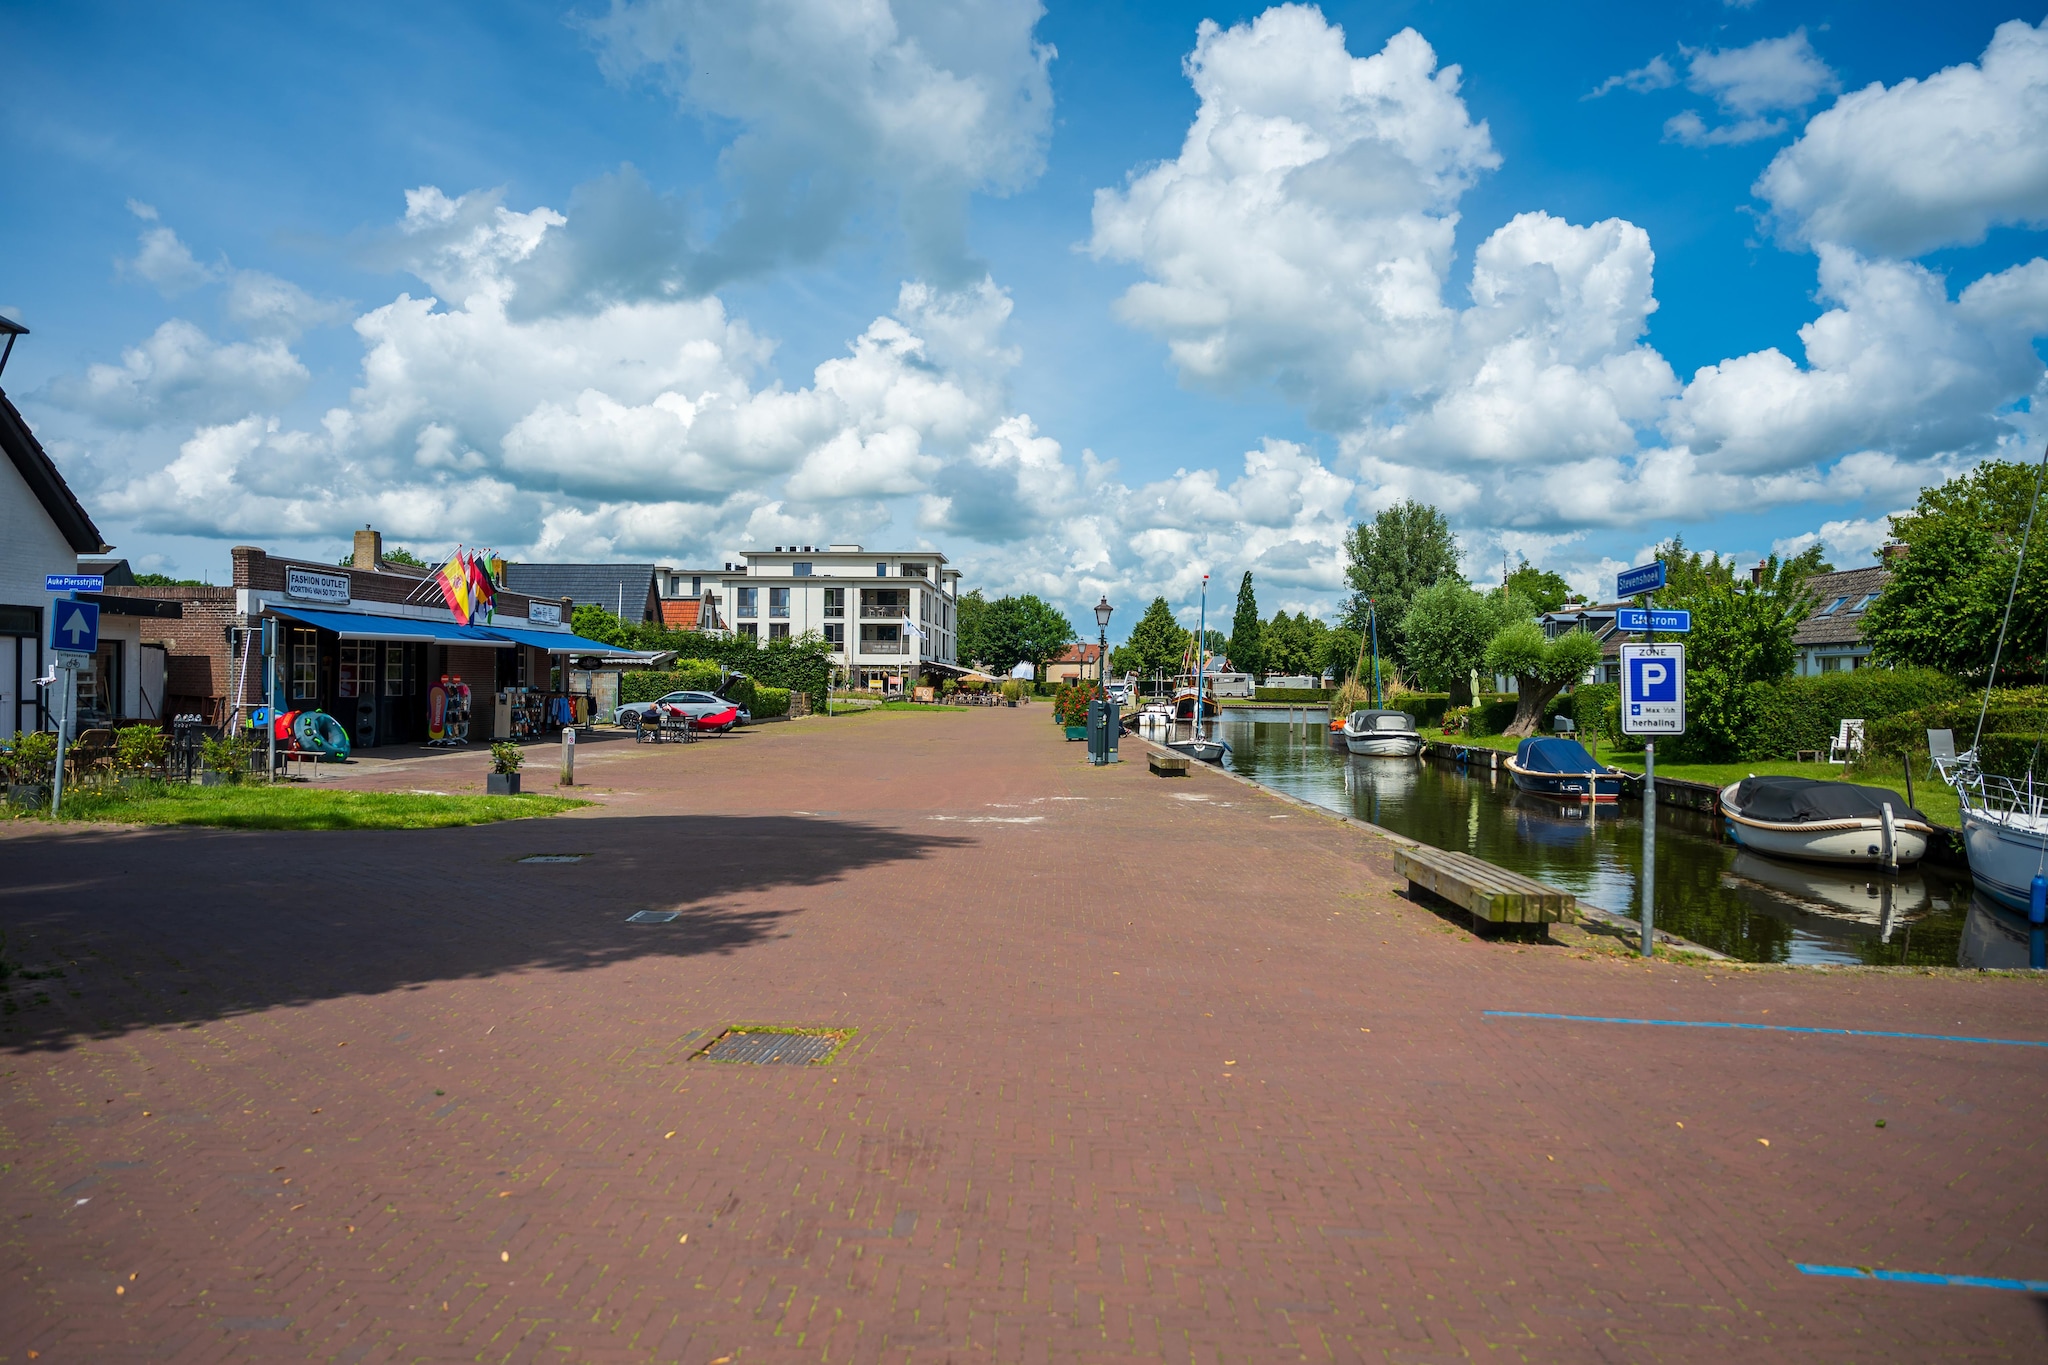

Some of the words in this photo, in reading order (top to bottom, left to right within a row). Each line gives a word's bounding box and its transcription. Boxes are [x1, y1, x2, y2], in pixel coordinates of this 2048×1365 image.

[47, 577, 63, 585] Auke
[64, 577, 102, 588] Piersstrjitte
[291, 574, 320, 586] FASHION
[321, 578, 347, 589] OUTLET
[1619, 569, 1659, 590] Stevenshoek
[290, 585, 313, 594] KORTING
[313, 587, 322, 595] VAN
[322, 588, 329, 596] 50
[329, 589, 338, 597] TOT
[1631, 614, 1677, 626] Efterom
[1639, 648, 1667, 656] ZONE
[1641, 663, 1667, 697] P
[1632, 719, 1676, 729] herhaling
